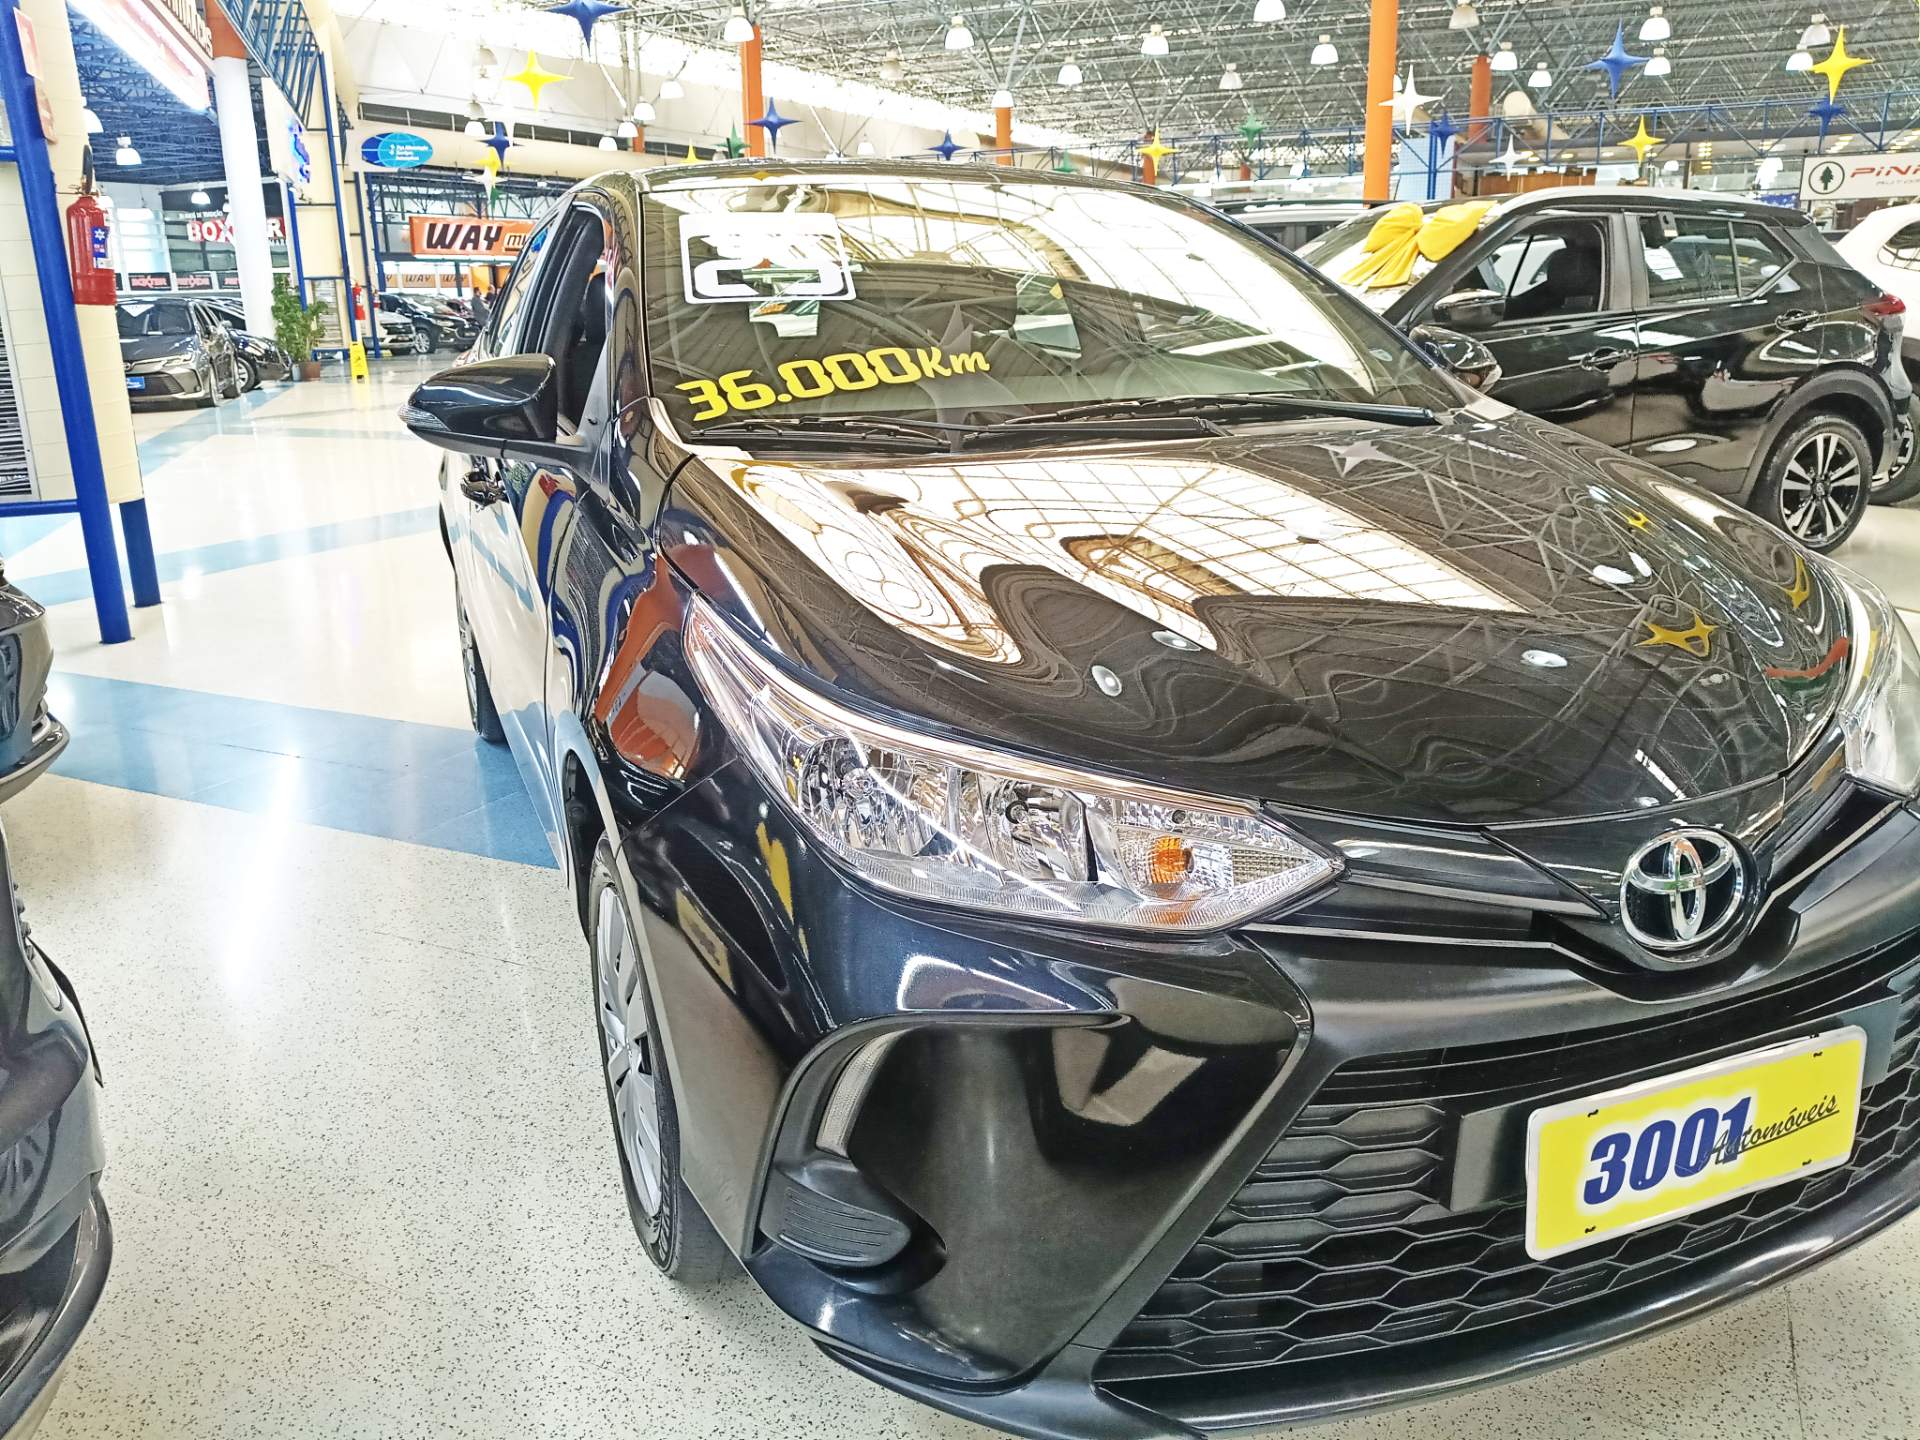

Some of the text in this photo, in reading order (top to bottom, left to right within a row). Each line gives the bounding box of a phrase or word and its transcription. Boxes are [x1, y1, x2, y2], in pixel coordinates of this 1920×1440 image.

[187, 217, 286, 242] BOXR
[425, 222, 503, 251] WAY
[405, 273, 432, 283] WAY
[1709, 1094, 1839, 1166] Automóveis
[1583, 1096, 1752, 1206] 3001
